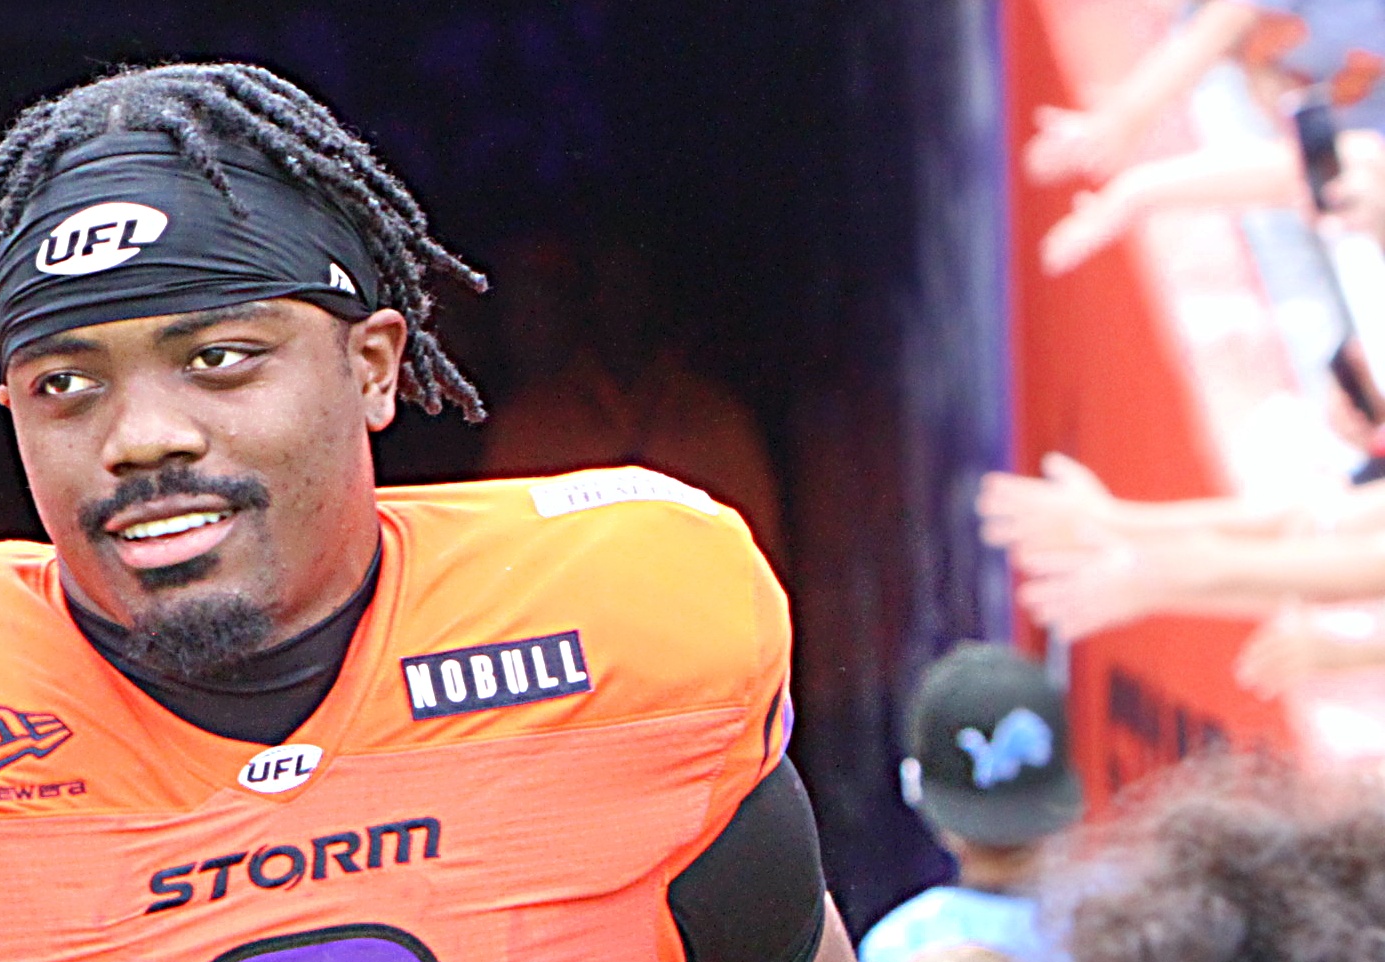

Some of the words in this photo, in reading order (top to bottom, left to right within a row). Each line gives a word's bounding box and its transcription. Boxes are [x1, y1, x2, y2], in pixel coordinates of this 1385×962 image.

[45, 219, 154, 266] UFL
[405, 640, 587, 709] NOBULL
[247, 754, 313, 783] UFL
[145, 815, 442, 914] STORM
